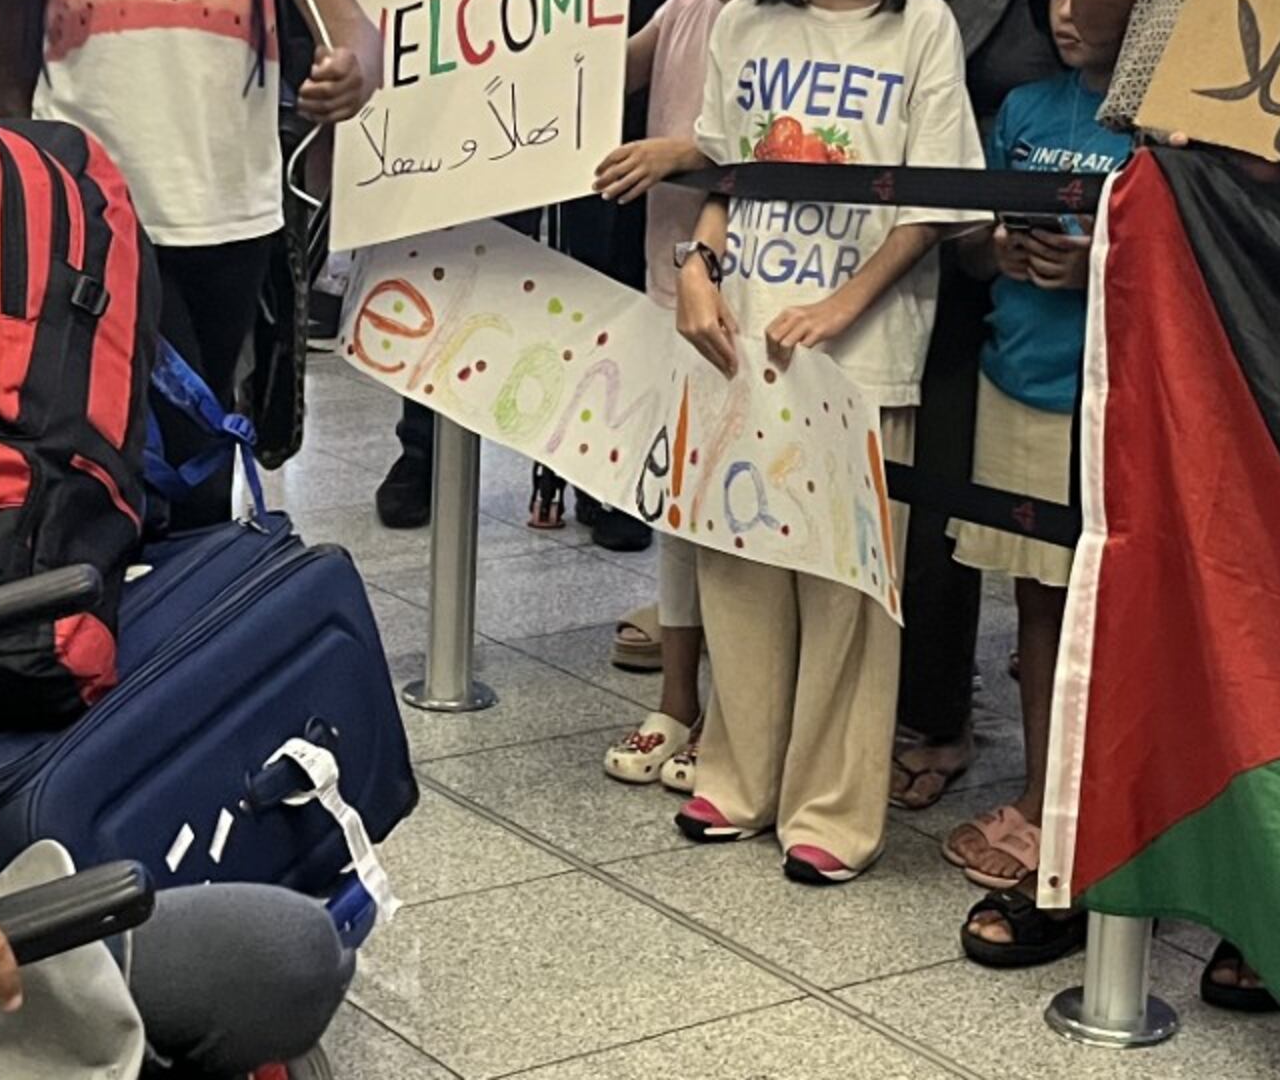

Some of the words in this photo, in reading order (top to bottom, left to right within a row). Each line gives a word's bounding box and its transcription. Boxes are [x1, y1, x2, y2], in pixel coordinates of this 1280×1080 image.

[736, 57, 905, 126] SWEET
[726, 199, 871, 242] WITHOUT
[722, 231, 862, 289] SUGAR
[352, 277, 690, 530] elcome!
